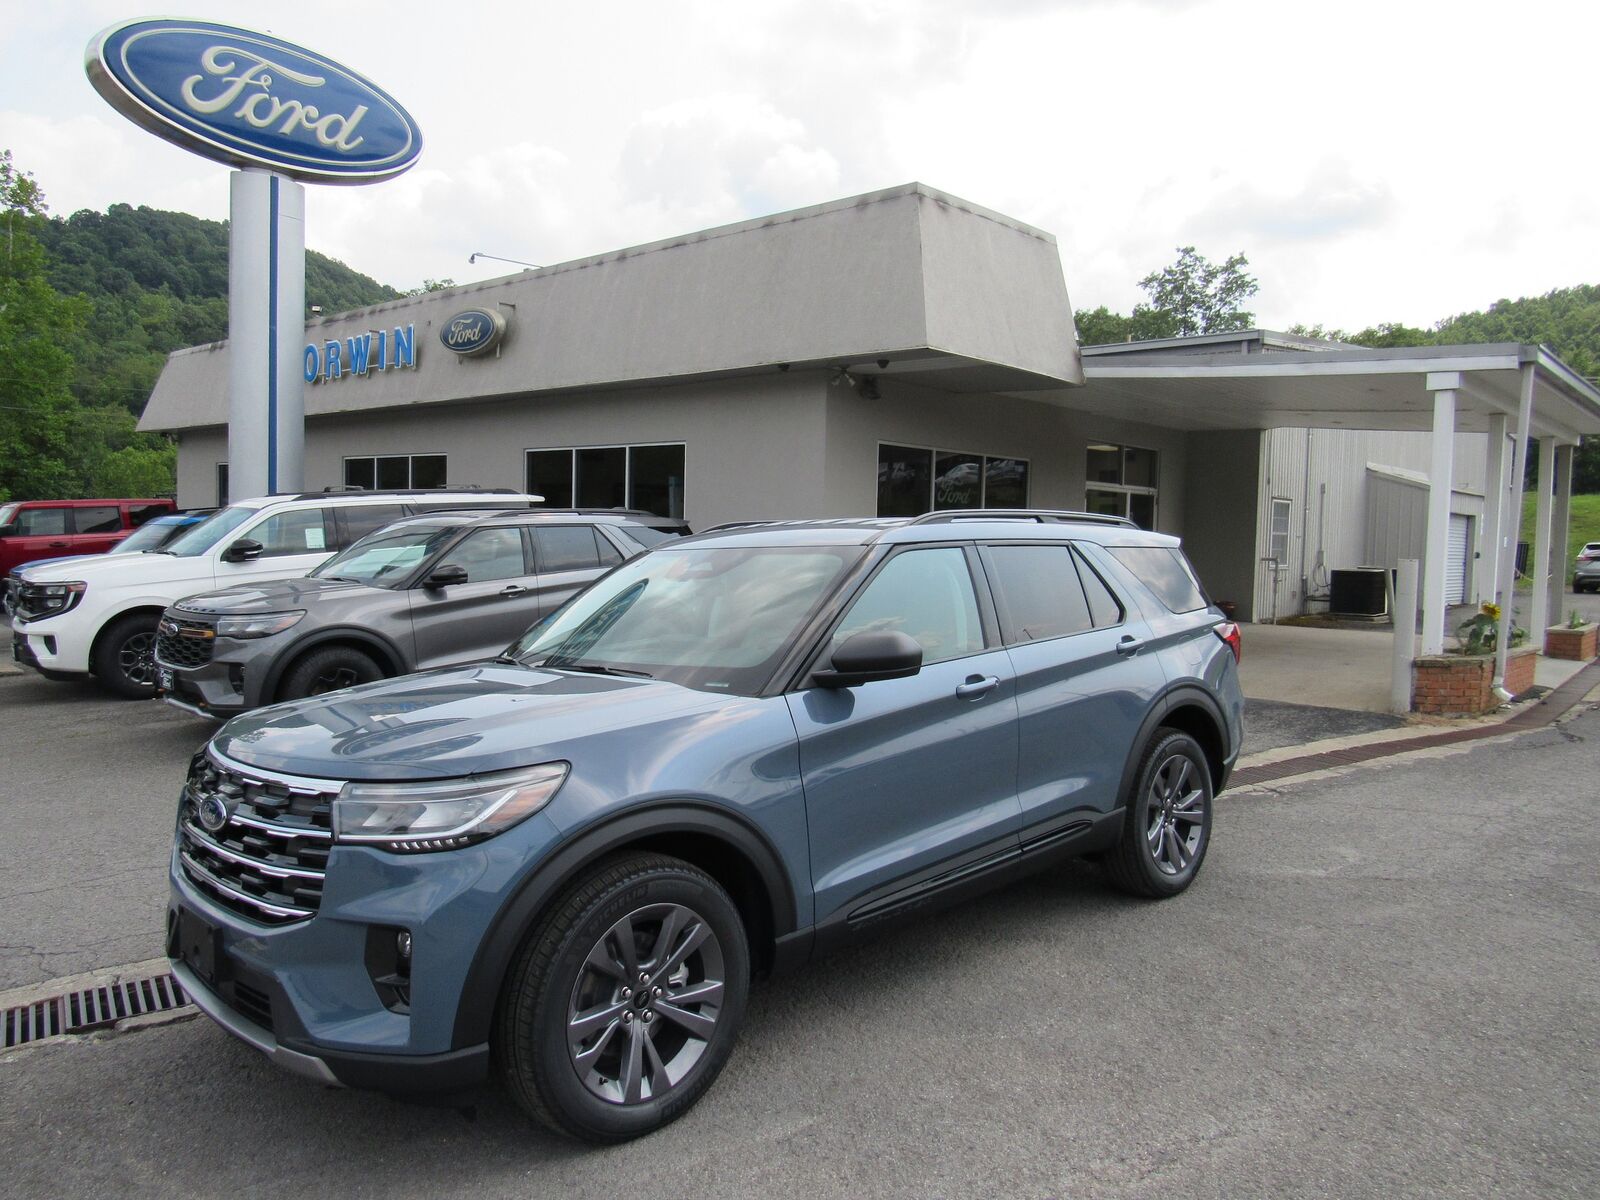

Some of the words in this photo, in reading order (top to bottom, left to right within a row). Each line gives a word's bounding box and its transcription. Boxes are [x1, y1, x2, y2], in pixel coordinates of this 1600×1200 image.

[181, 45, 369, 152] Ford
[448, 317, 482, 344] Ford
[304, 323, 415, 383] ORWIN
[937, 480, 971, 505] Ford
